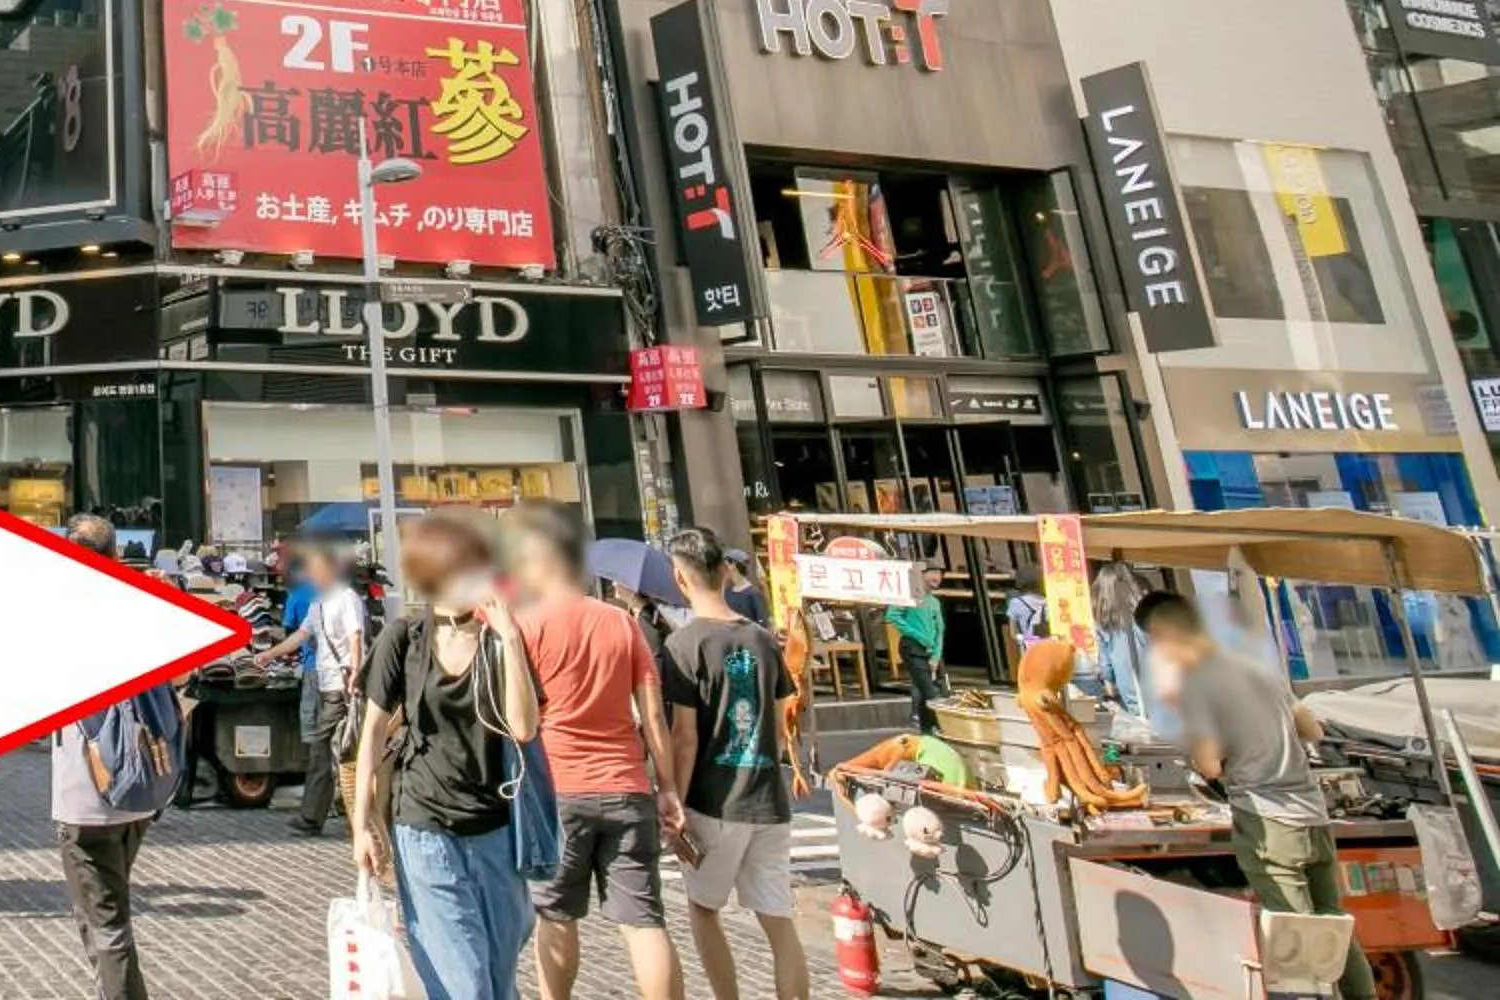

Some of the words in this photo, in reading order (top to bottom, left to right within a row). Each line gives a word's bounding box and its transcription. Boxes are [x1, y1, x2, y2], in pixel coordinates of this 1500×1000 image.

[280, 14, 369, 74] 2F
[1100, 103, 1185, 308] LANEIGE
[276, 287, 530, 343] LLOYD
[400, 345, 457, 365] GIFT
[1238, 389, 1399, 432] LANEIGE
